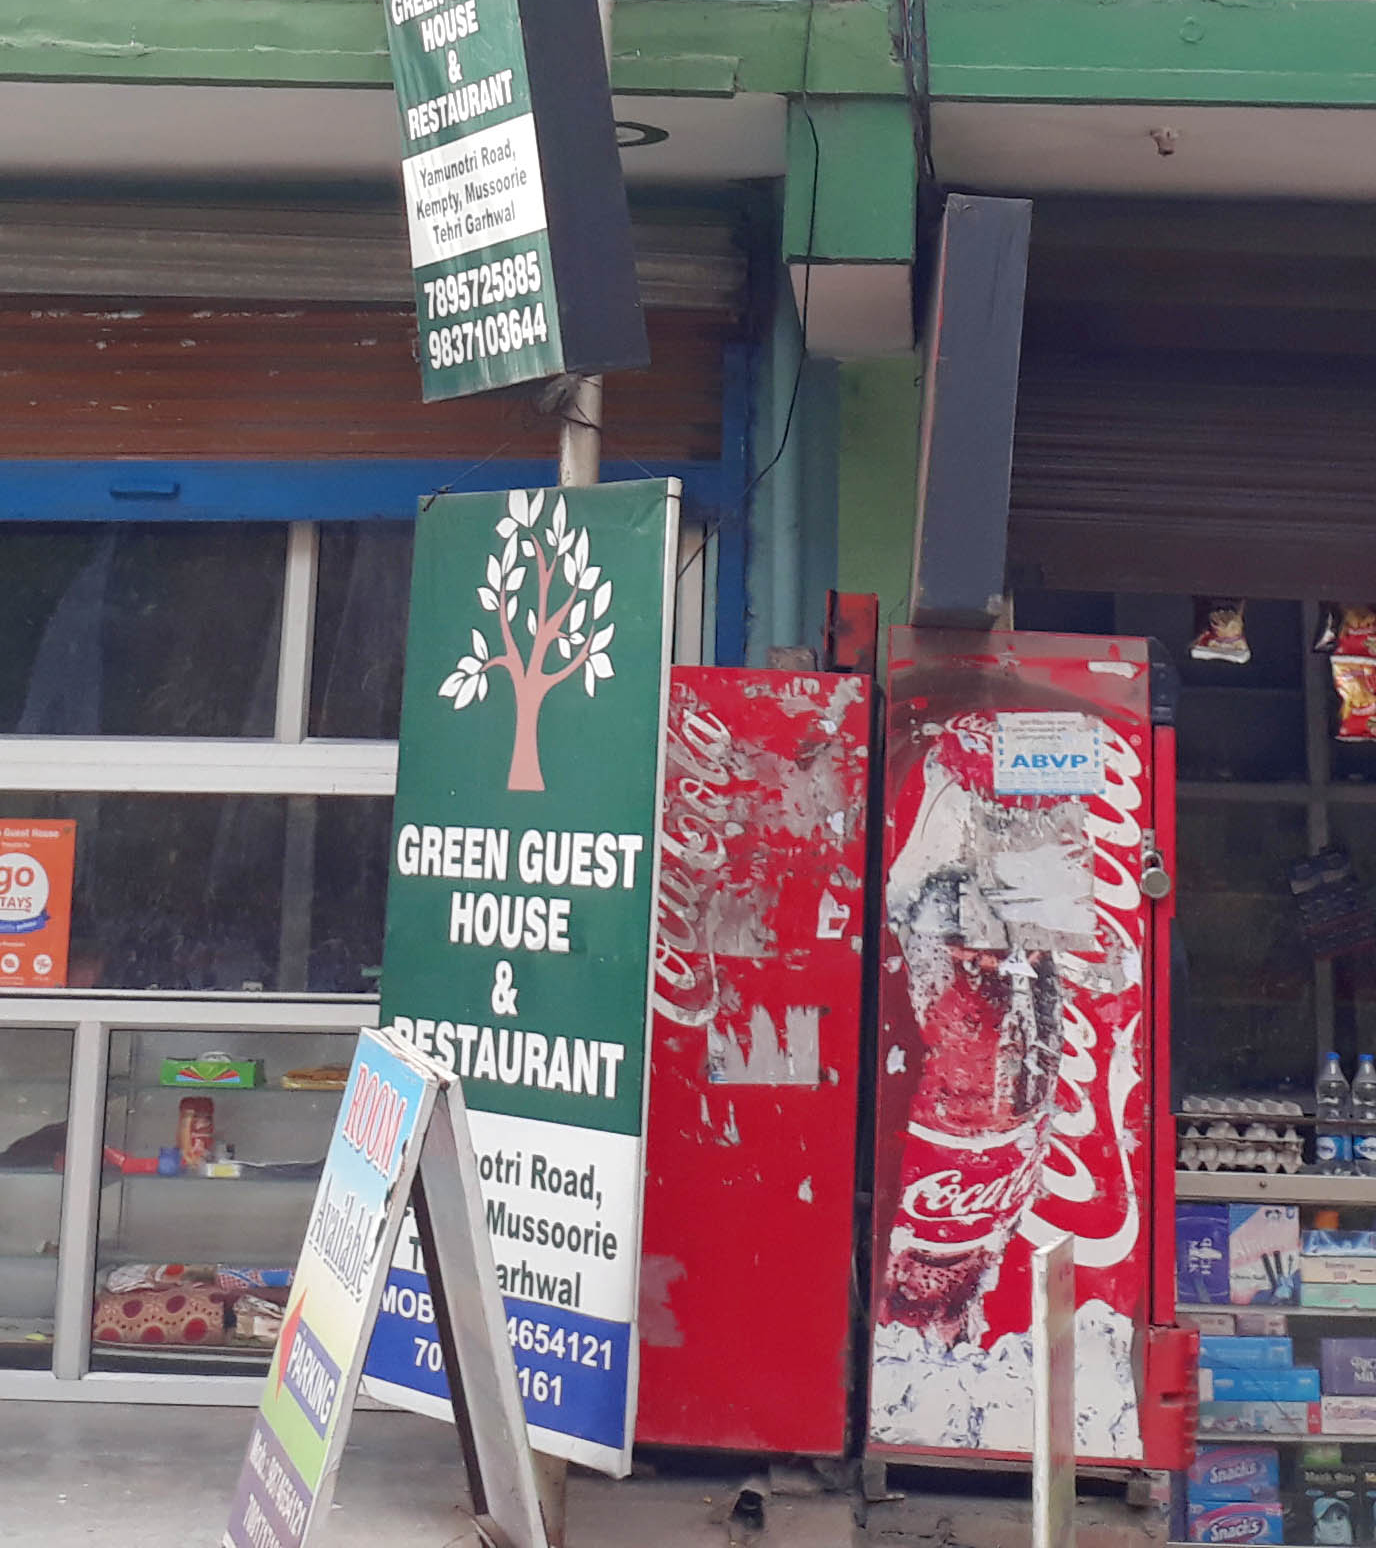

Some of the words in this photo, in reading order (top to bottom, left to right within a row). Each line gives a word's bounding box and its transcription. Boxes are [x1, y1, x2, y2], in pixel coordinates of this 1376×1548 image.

[447, 49, 462, 84] &
[408, 68, 513, 140] RESTAURANT
[416, 192, 464, 221] Kempty,
[464, 167, 528, 202] Mussoorie
[419, 150, 478, 189] Yamunotri
[481, 138, 517, 168] Road,
[432, 219, 462, 246] Tehri
[465, 200, 516, 236] Garhwal
[423, 250, 542, 320] 7895725885
[428, 302, 548, 369] 9837103644
[1010, 754, 1089, 768] ABVP
[397, 824, 509, 880] GREEN
[518, 829, 643, 889] GUEST
[449, 891, 571, 953] HOUSE
[491, 960, 518, 1016] &
[343, 1063, 407, 1178] ROOM
[530, 1154, 603, 1211] Road,
[308, 1173, 377, 1302] Available
[486, 1200, 618, 1261] Mussoorie
[287, 1332, 337, 1424] PARKING
[1210, 1515, 1261, 1542] Snacks
